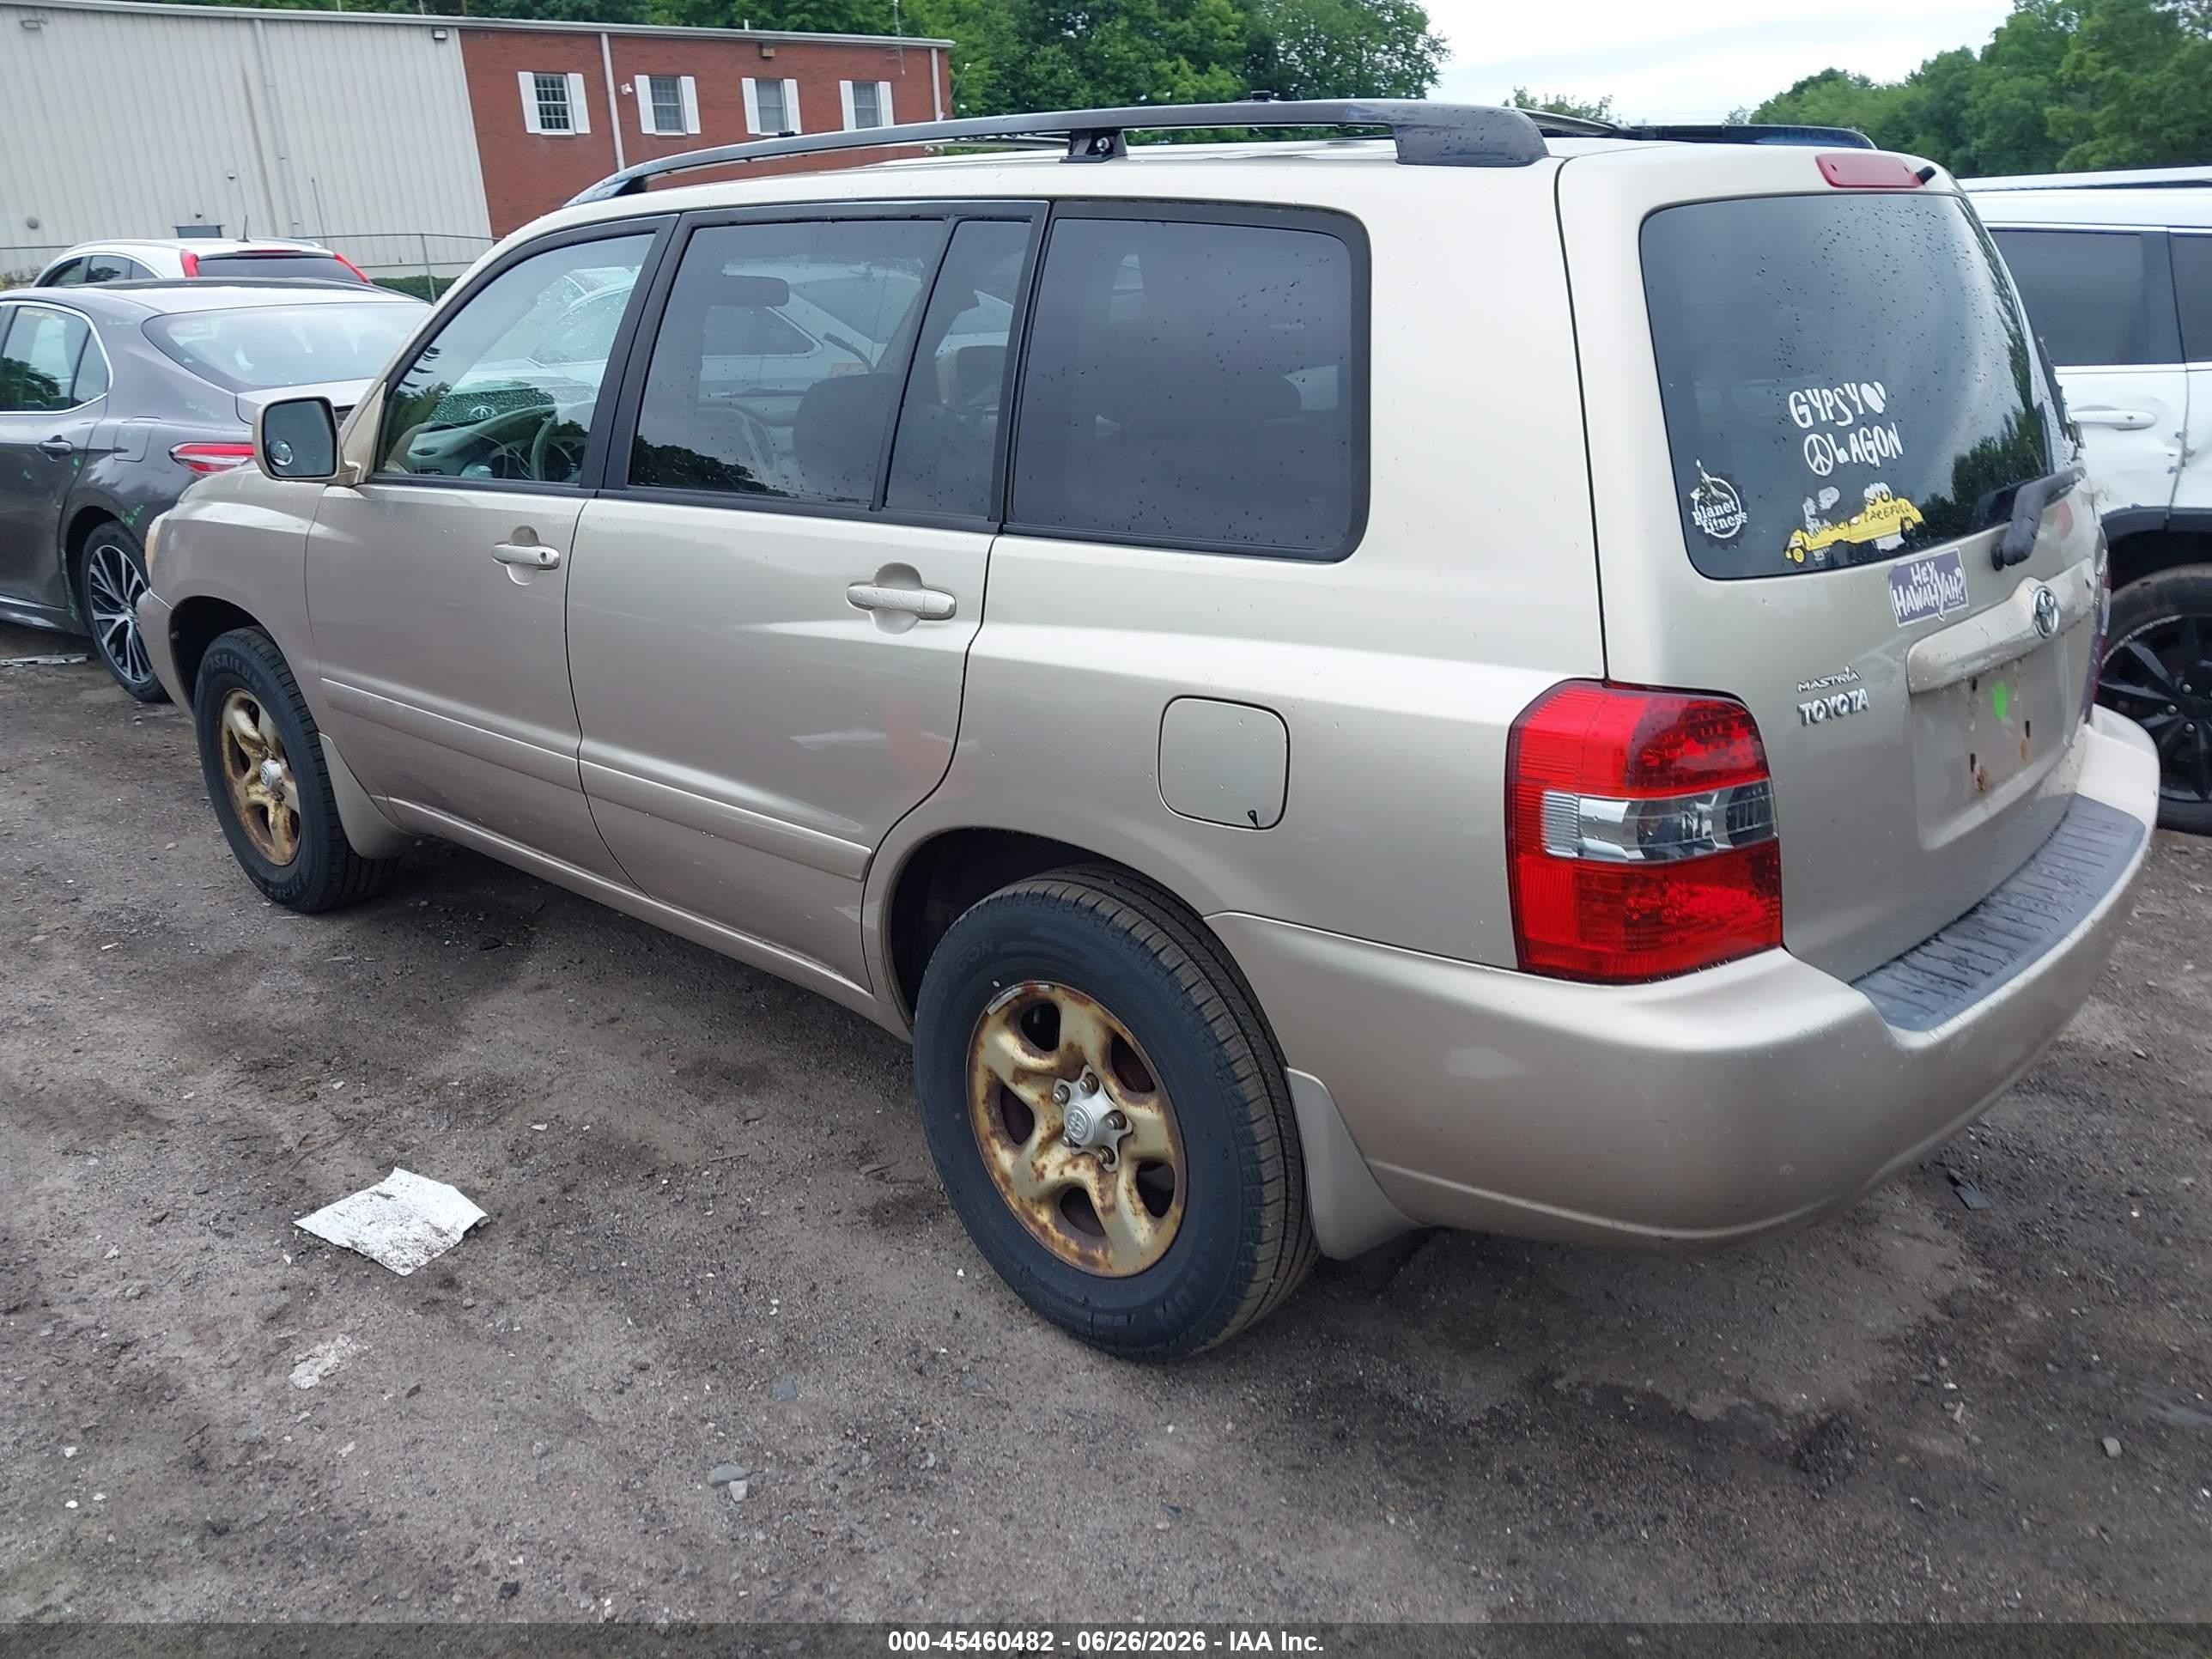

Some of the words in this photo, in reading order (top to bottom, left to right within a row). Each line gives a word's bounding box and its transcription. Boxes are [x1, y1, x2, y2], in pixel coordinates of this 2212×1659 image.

[1789, 382, 1865, 428] GYPSY
[1910, 561, 1936, 586] HEY
[1797, 687, 1870, 726] TOYOTA
